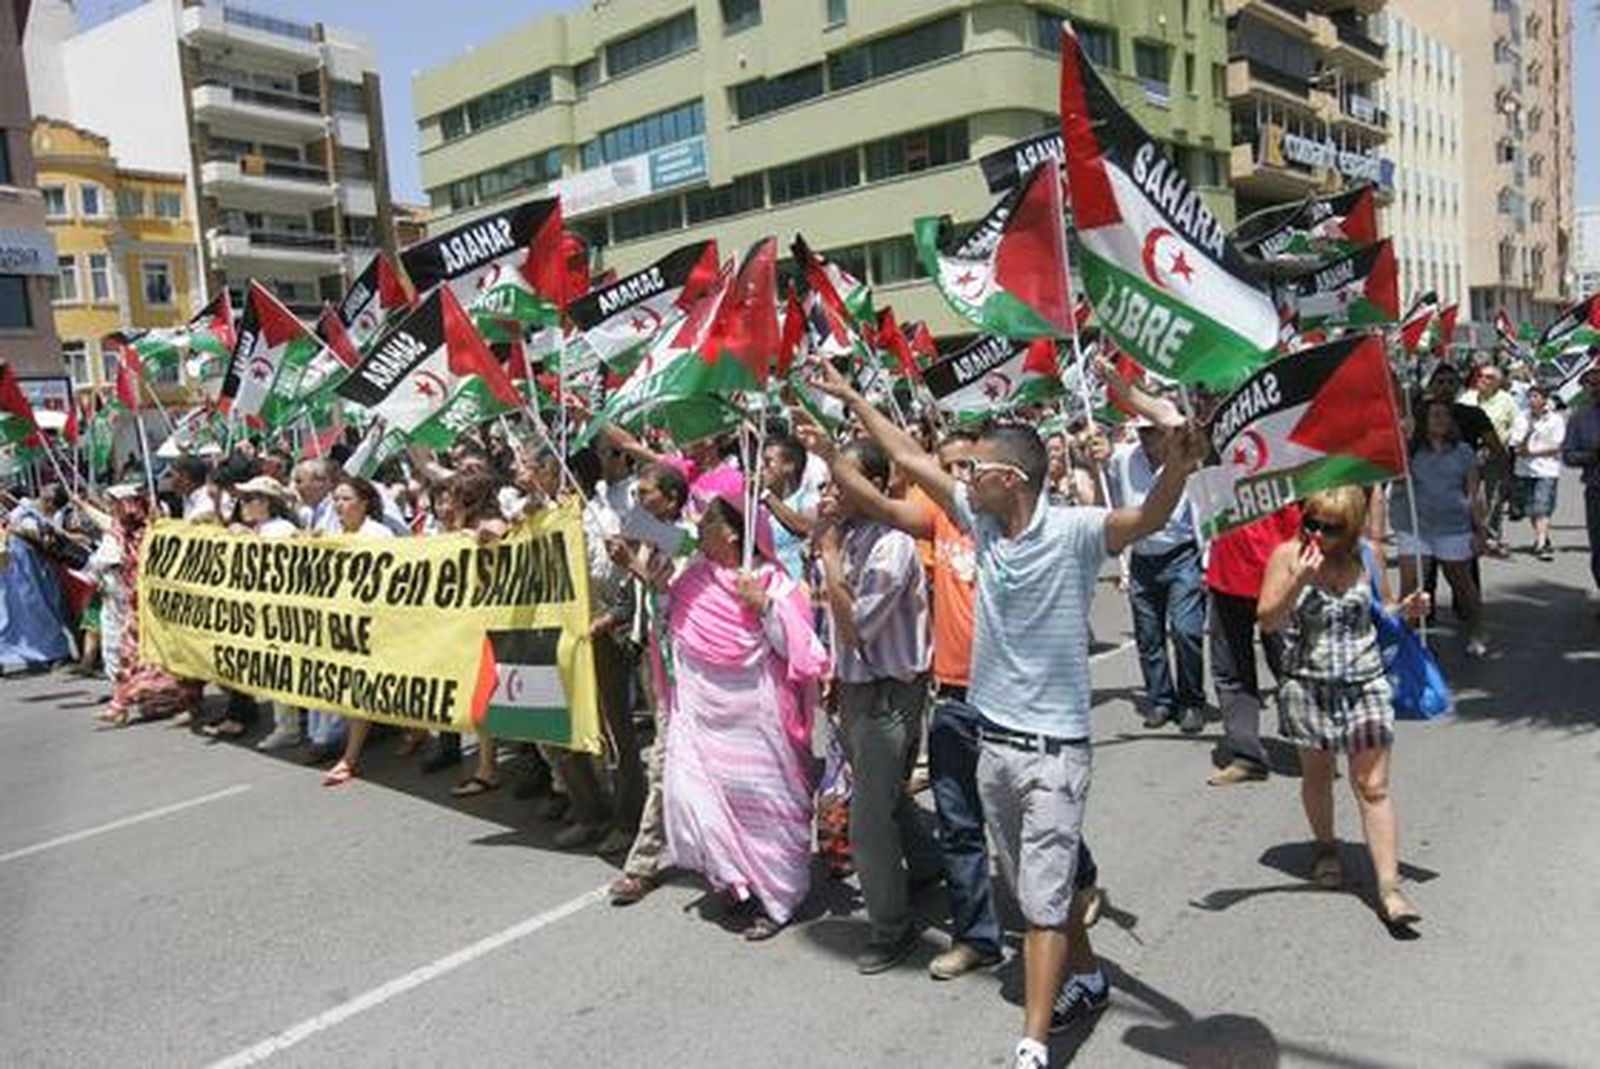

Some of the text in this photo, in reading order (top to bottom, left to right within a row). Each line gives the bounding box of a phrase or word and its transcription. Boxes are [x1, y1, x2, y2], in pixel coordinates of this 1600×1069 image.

[1132, 142, 1226, 258] SAHARA
[1100, 276, 1196, 368] LIBRE
[145, 533, 182, 579] NO
[174, 536, 229, 588] MAS
[385, 558, 431, 607] en
[433, 547, 472, 609] el
[214, 643, 459, 725] ESPAÑA RESPONSABLE
